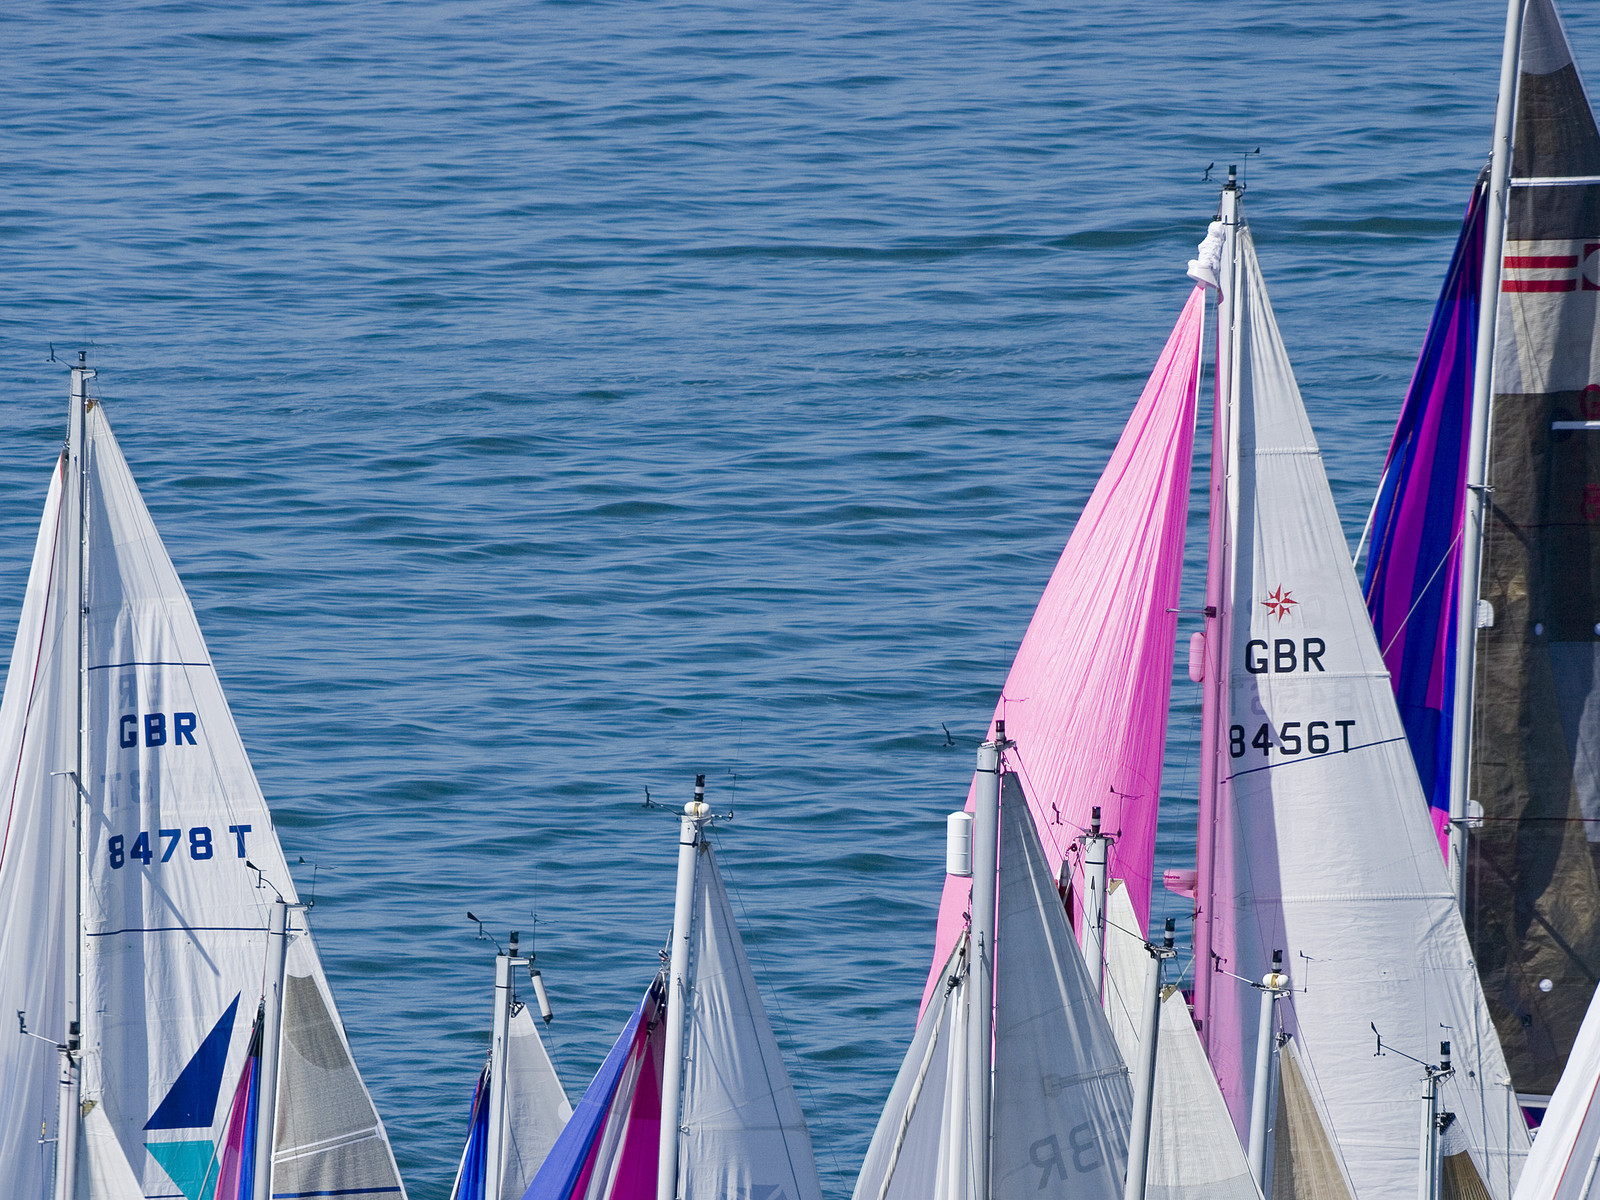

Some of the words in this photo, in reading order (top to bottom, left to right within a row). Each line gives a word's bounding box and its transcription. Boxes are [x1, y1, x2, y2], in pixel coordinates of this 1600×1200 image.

[1245, 637, 1326, 674] GBR
[120, 712, 197, 749] GBR
[1229, 720, 1356, 758] 8456T
